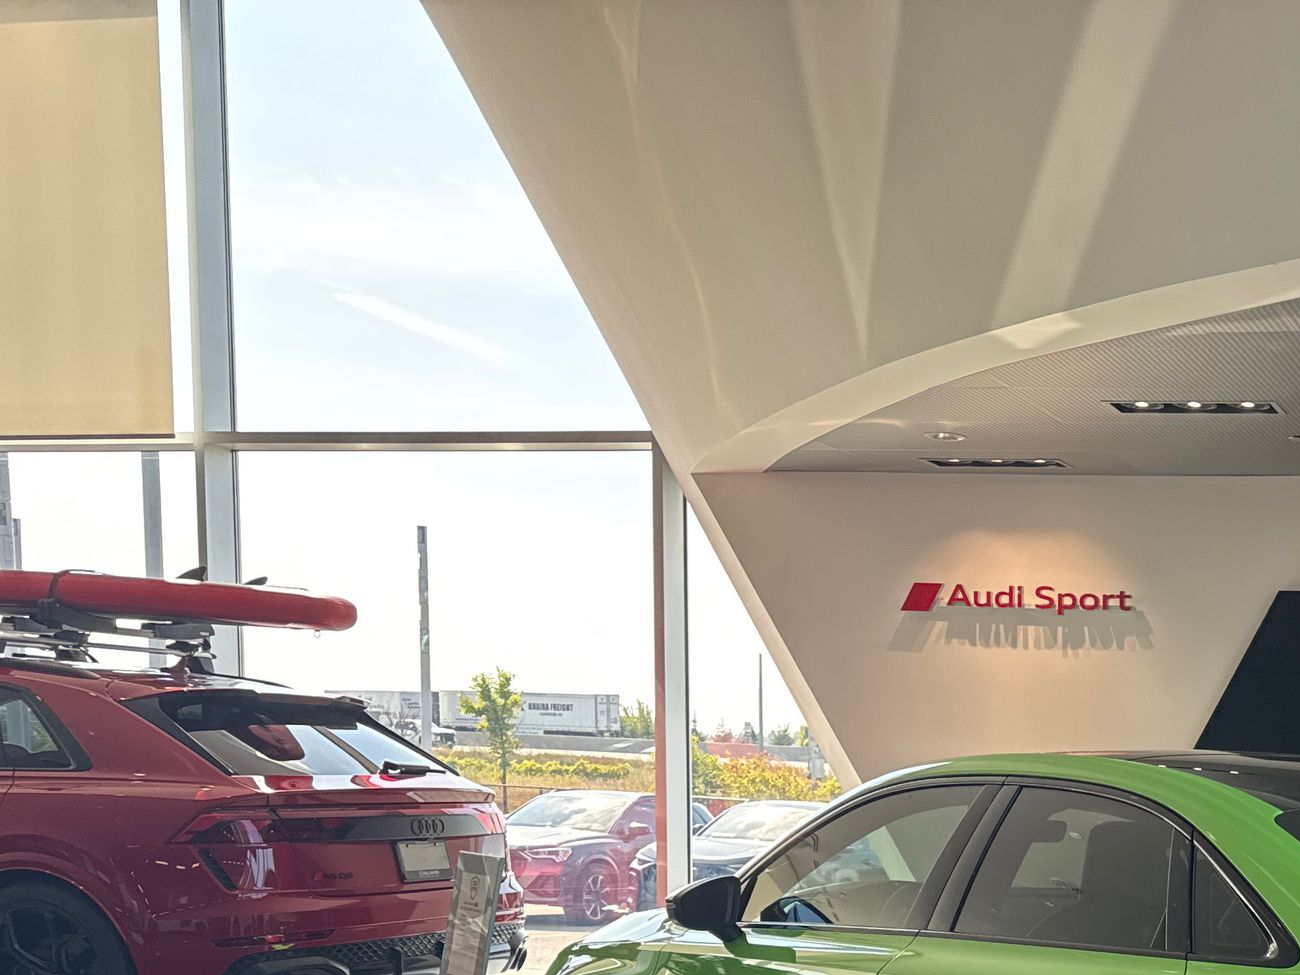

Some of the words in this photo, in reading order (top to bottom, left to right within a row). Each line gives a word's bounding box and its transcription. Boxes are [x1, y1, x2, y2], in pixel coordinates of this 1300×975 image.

[946, 584, 1024, 608] Audi
[1034, 586, 1133, 615] Sport
[550, 703, 574, 712] FREIGHT
